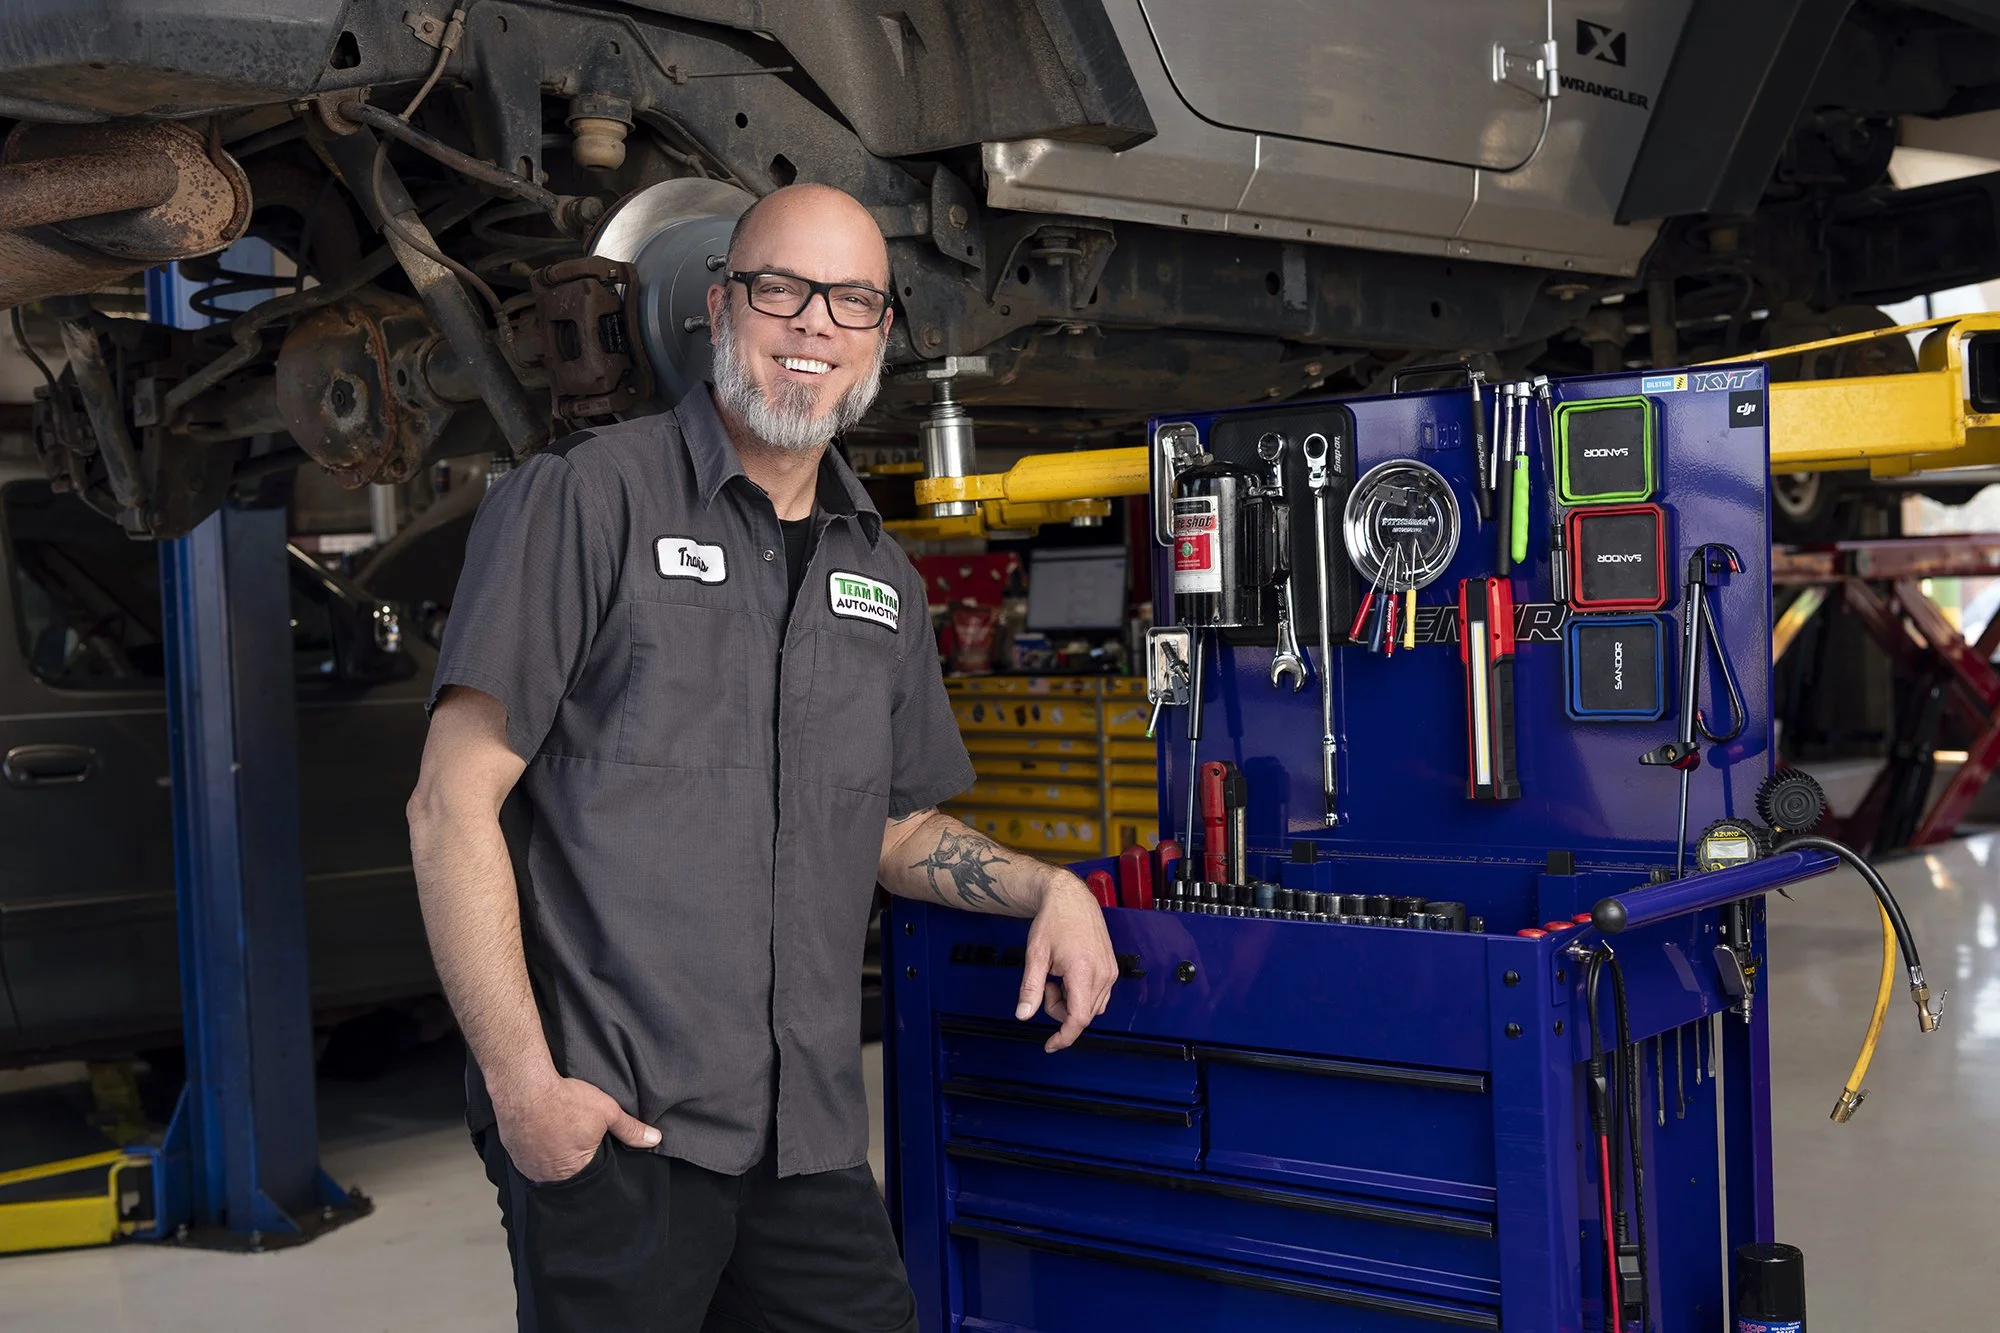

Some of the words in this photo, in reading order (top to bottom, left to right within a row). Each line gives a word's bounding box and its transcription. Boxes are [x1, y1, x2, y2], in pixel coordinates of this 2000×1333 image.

[1560, 75, 1649, 110] WRANGLER
[1646, 380, 1672, 389] BILSTEIN
[1694, 369, 1760, 392] KYT
[1583, 447, 1629, 458] SANDOR
[1597, 554, 1642, 563] SANDOR
[1614, 641, 1623, 690] SANDOR
